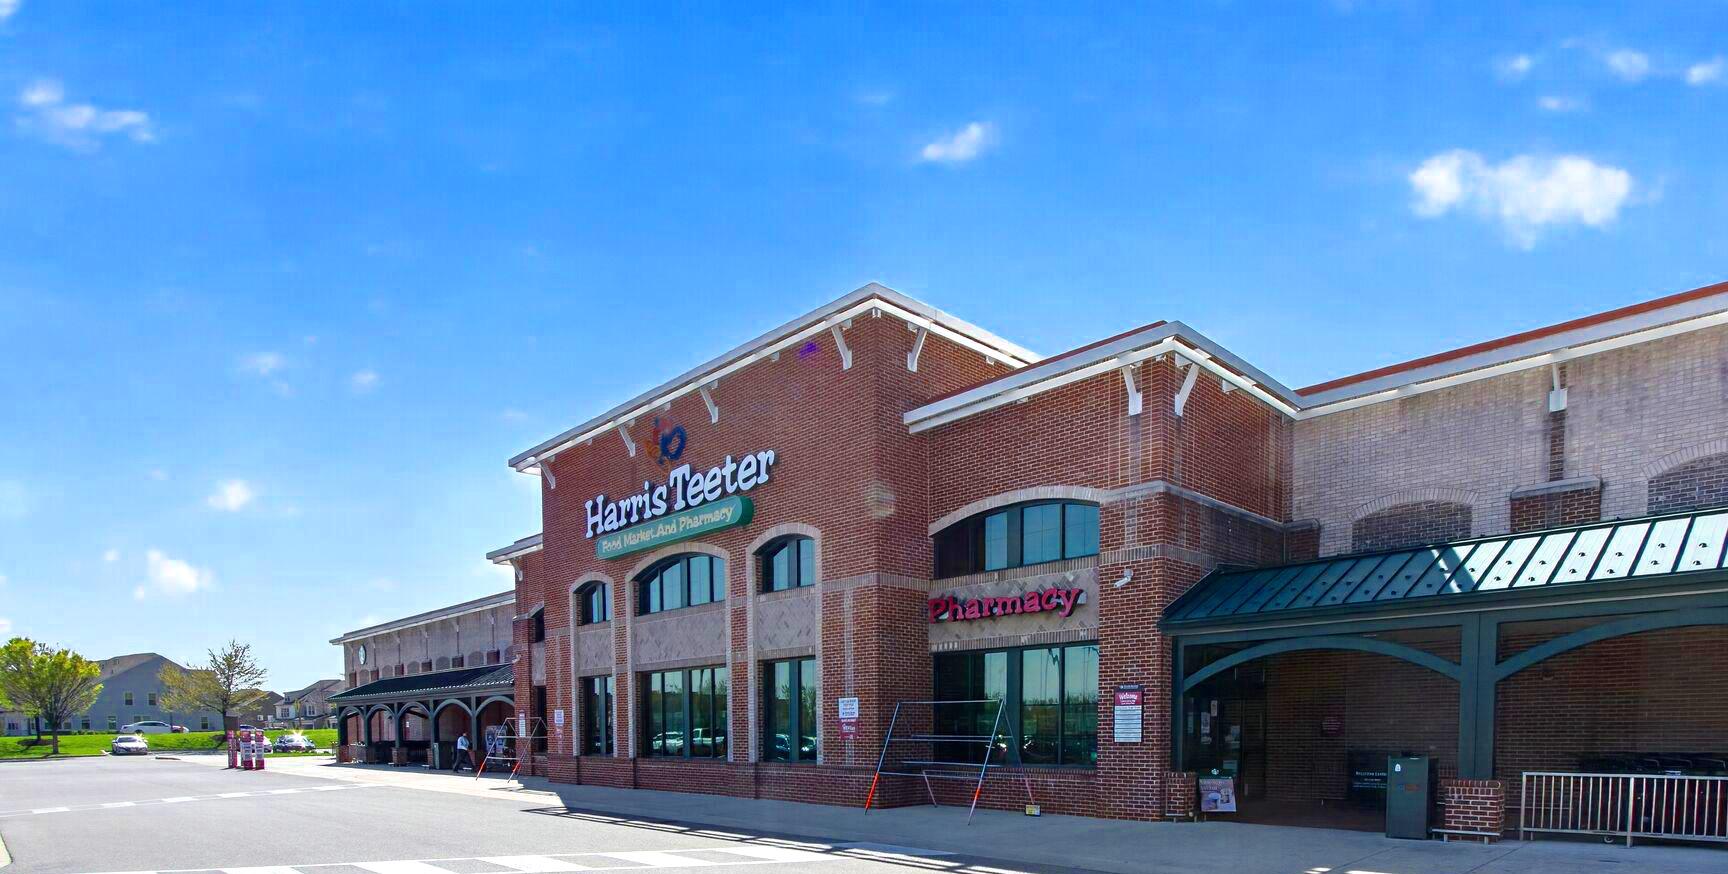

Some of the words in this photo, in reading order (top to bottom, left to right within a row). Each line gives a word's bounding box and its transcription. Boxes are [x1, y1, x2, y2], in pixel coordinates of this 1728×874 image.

[585, 481, 668, 539] Harris
[669, 450, 776, 511] Teeter
[602, 535, 622, 553] Food
[623, 527, 653, 546] Market
[654, 520, 677, 536] And
[679, 504, 736, 531] Pharmacy
[928, 587, 1083, 624] Pharmacy
